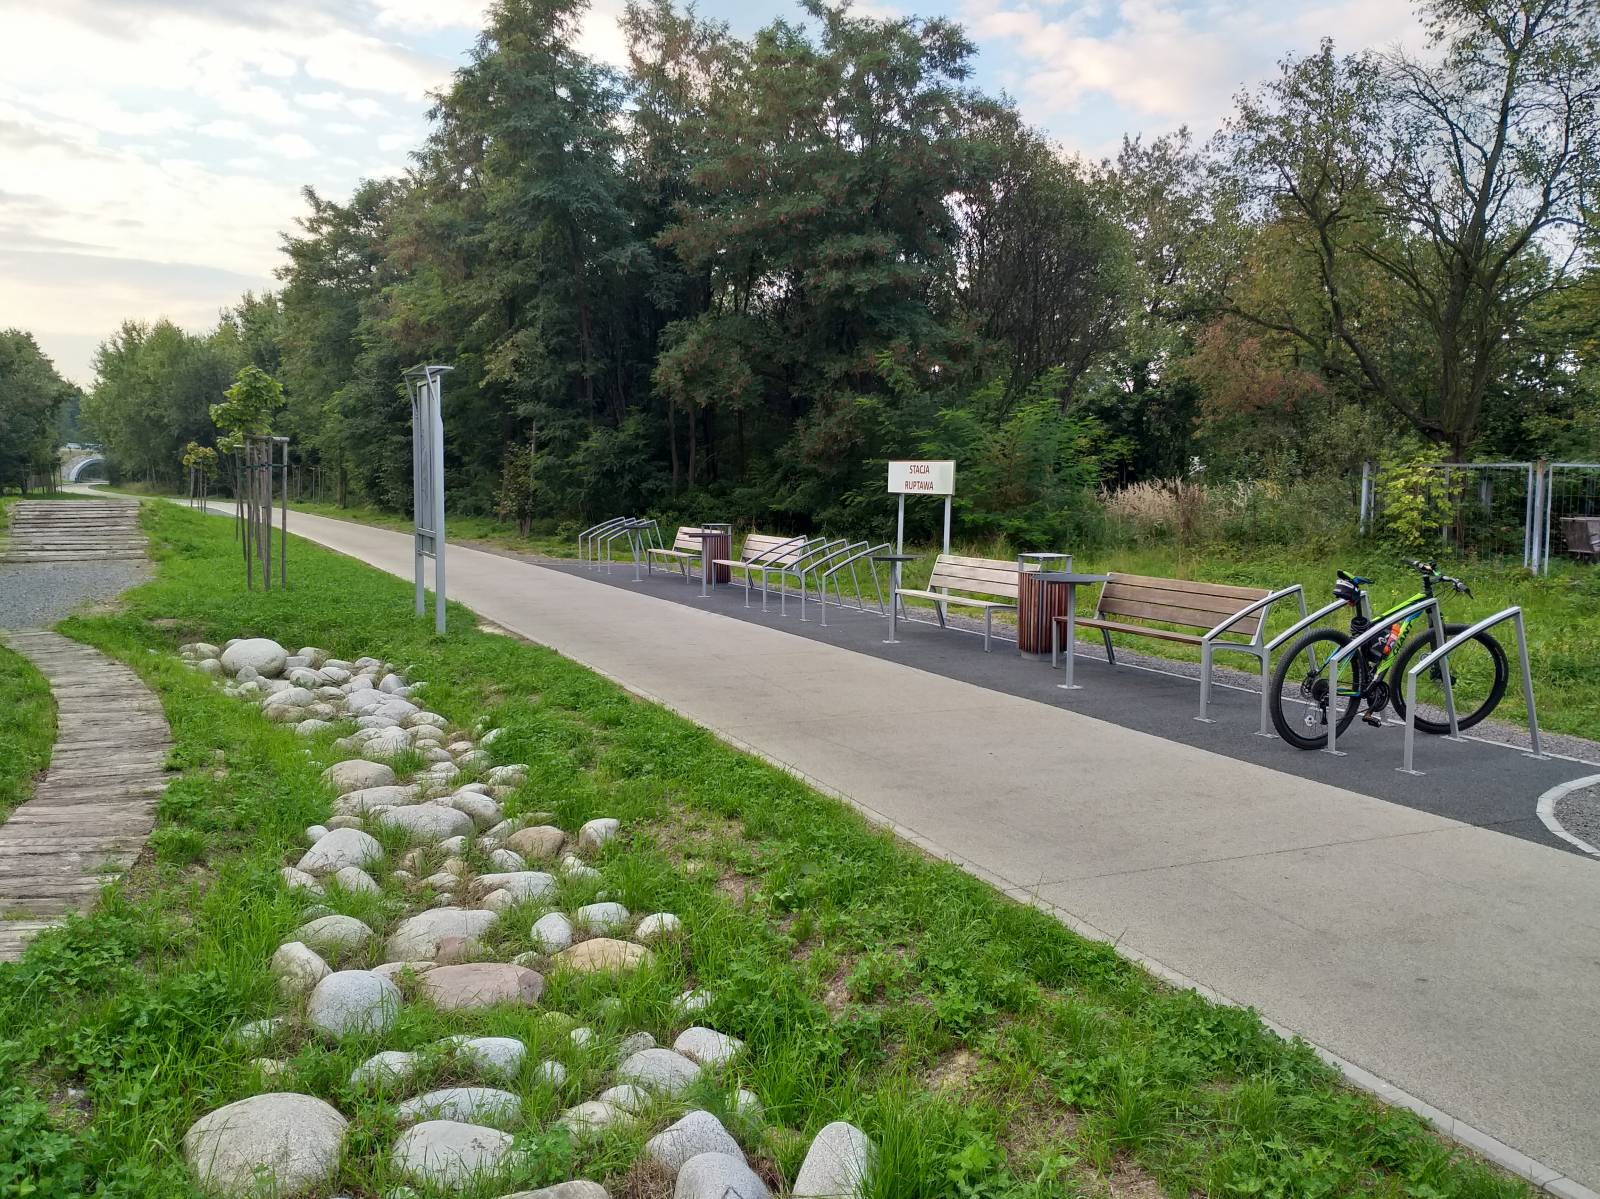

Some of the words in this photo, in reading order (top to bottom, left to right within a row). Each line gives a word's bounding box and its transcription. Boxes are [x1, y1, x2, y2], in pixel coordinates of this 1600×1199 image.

[909, 464, 930, 474] STACJA
[904, 480, 934, 491] RUPTAWA
[1393, 622, 1412, 656] GIANT
